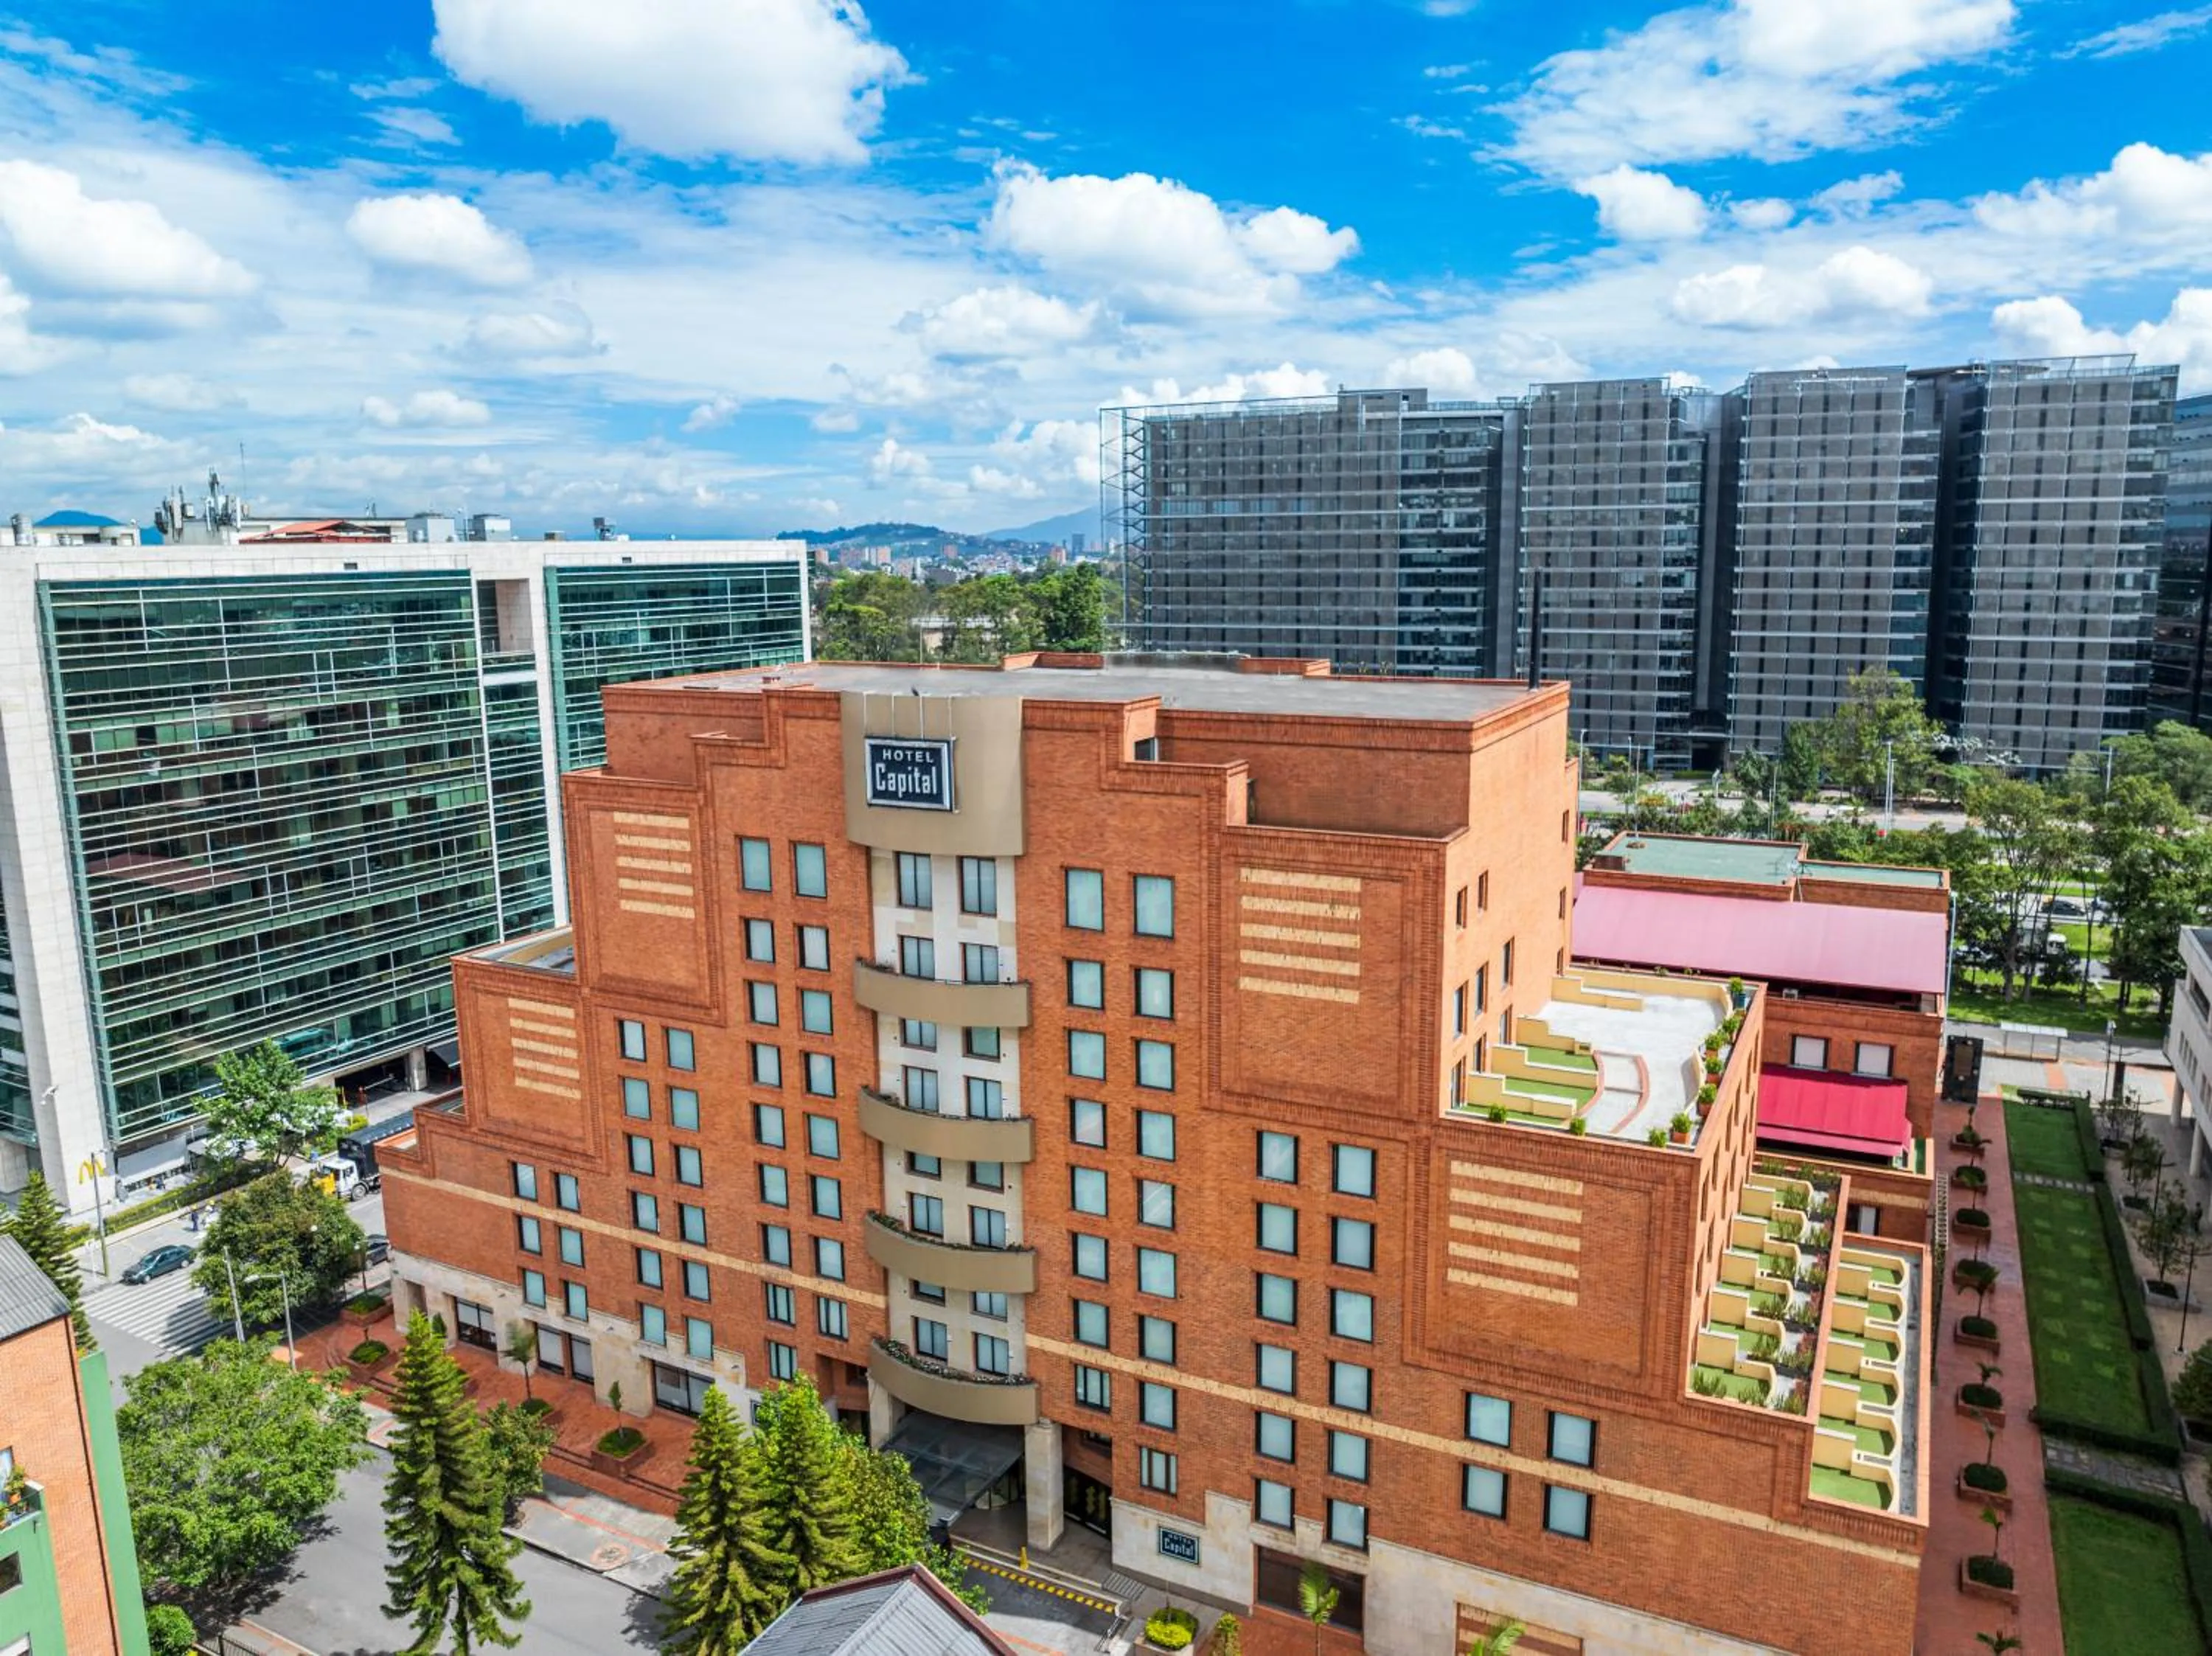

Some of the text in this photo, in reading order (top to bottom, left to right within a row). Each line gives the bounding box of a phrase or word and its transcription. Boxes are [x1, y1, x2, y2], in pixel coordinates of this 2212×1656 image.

[883, 748, 934, 763] HOTEL
[875, 762, 937, 798] Capital
[1164, 1537, 1194, 1556] Capital
